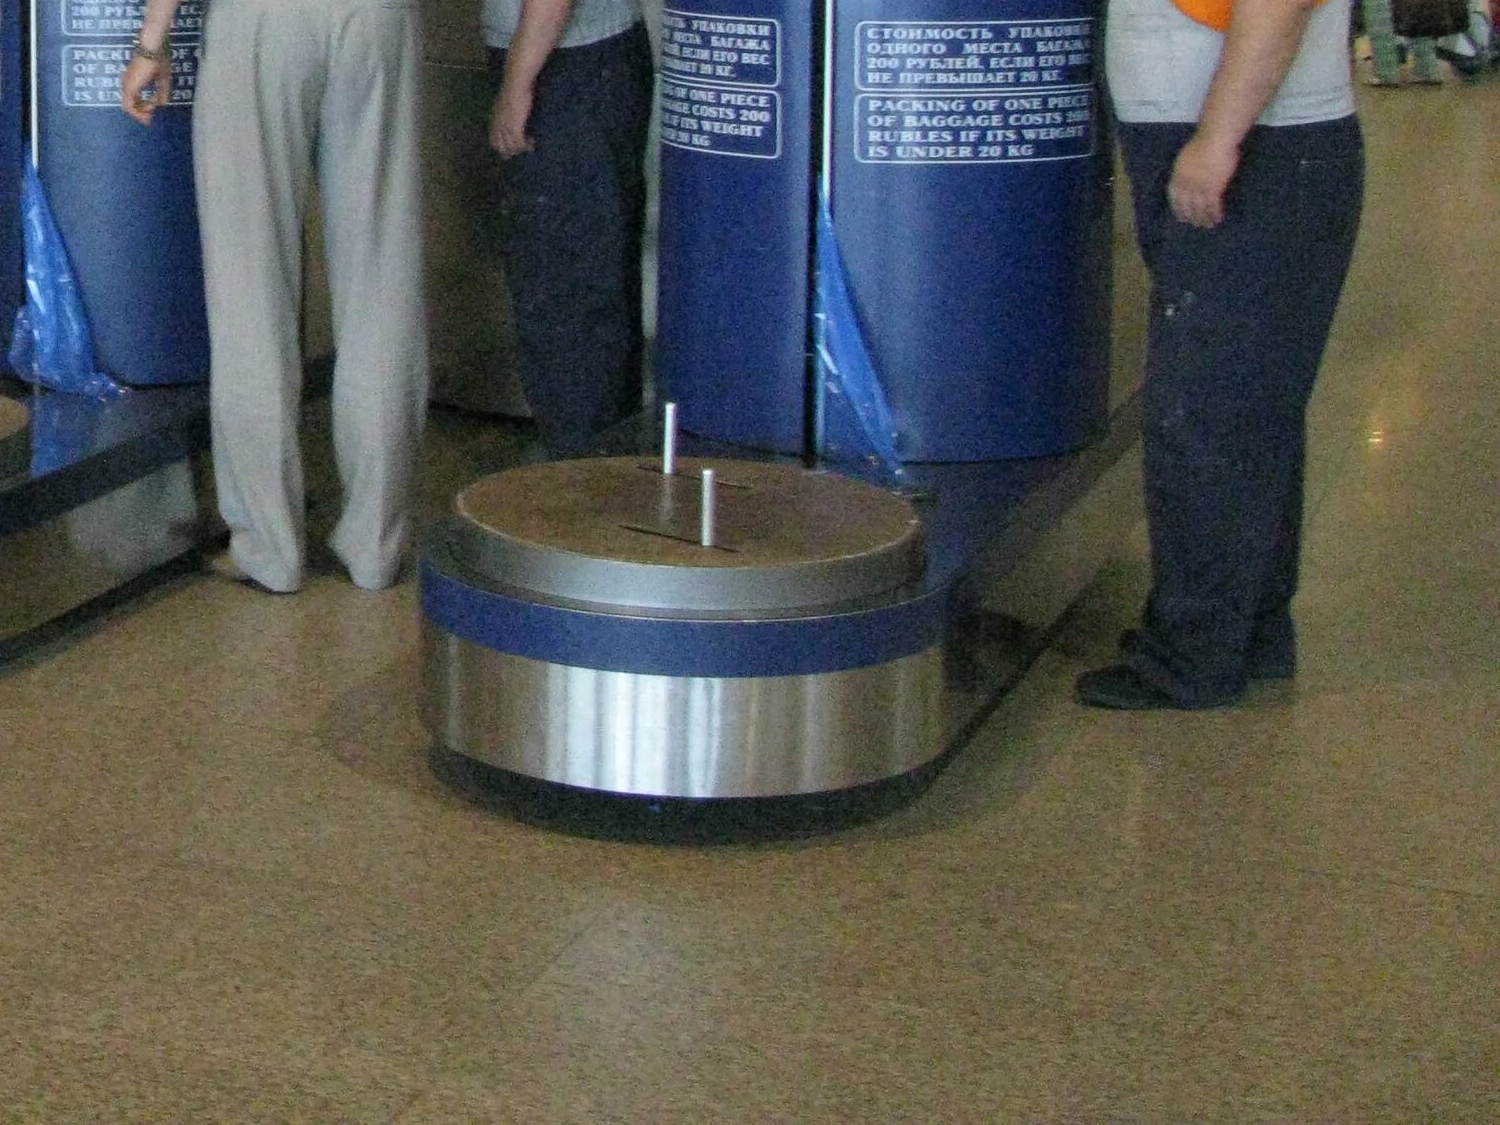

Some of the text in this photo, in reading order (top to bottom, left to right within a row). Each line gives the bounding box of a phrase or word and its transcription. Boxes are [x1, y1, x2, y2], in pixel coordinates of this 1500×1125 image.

[867, 27, 993, 40] СТОИМОСТЬ
[710, 35, 770, 51] БАГАЖА
[867, 42, 947, 55] ОДНОГО
[962, 42, 1023, 54] МЕСТА
[74, 49, 132, 61] PACKI
[741, 53, 770, 65] ВЕС
[73, 63, 98, 74] OF
[867, 57, 899, 69] 200
[990, 56, 1036, 68] ЕСЛИ
[867, 71, 893, 84] НЕ
[900, 71, 1017, 84] ПРЕВЫШАЕТ
[74, 91, 93, 101] IS
[720, 92, 771, 108] PIECE
[868, 95, 1090, 113] PACKING OF ONE PIECE
[692, 104, 737, 120] COSTS
[739, 109, 771, 123] 200
[867, 114, 898, 127] OF
[904, 114, 1003, 127] BAGGAGE
[1008, 113, 1062, 126] COSTS
[700, 120, 764, 137] WEIGHT
[868, 126, 1084, 143] RUBLES IF ITS WEIGHT
[868, 144, 1035, 158] IS UNDER 20 KG
